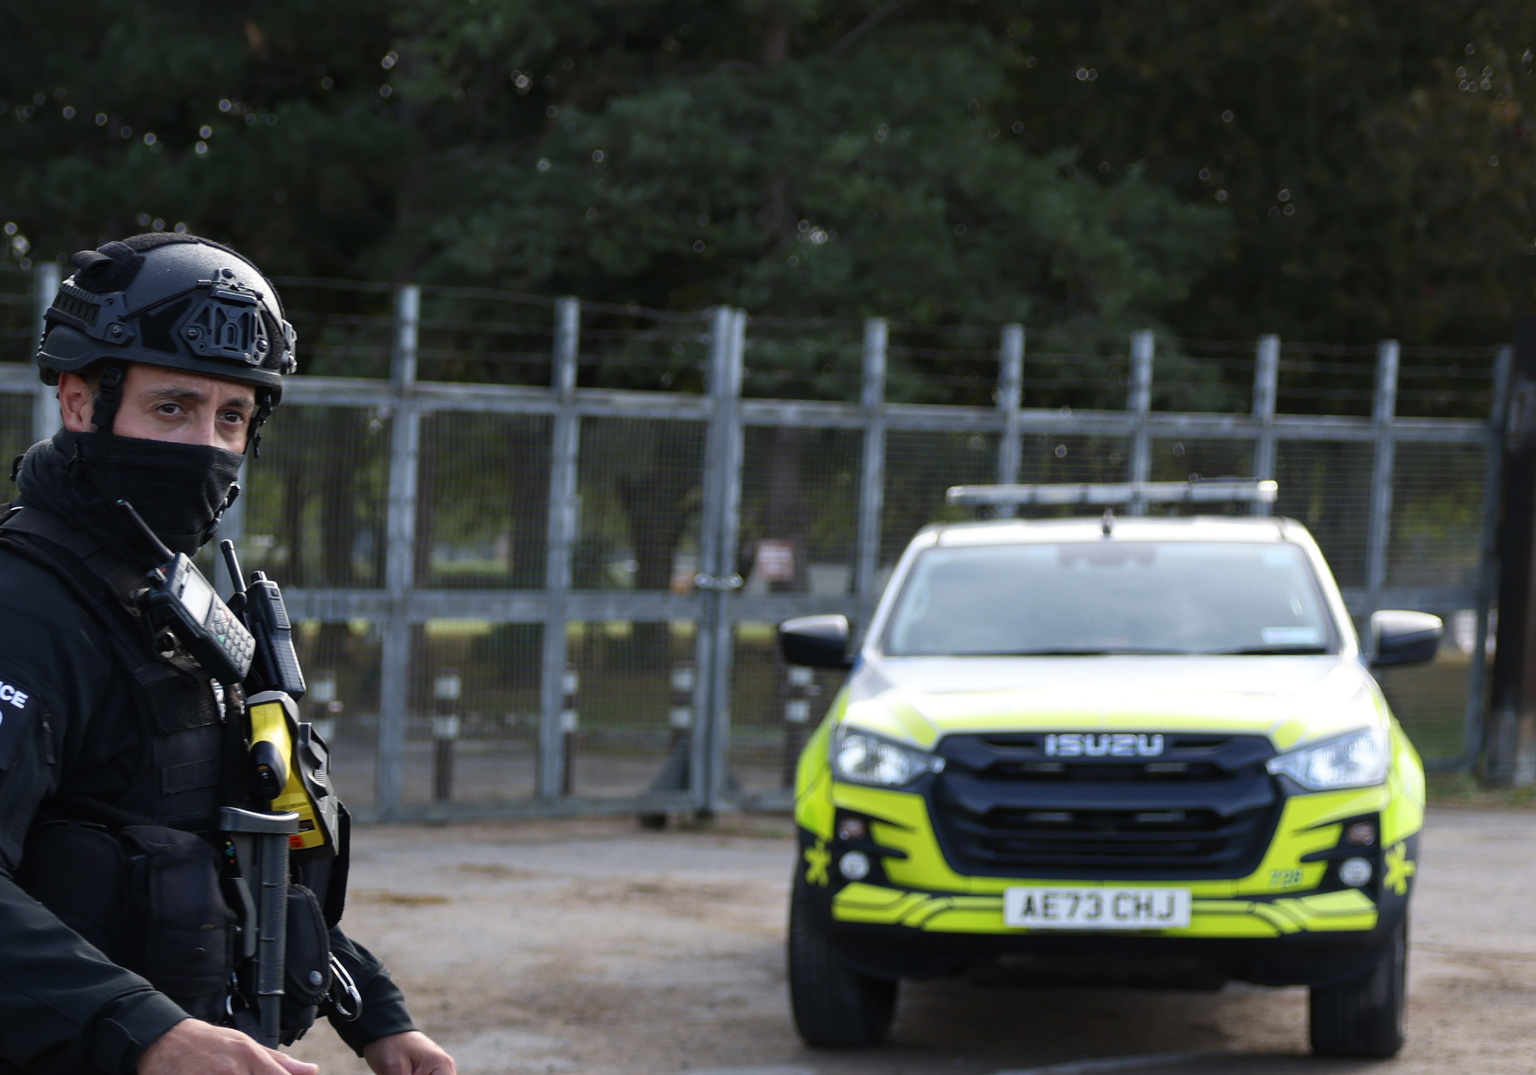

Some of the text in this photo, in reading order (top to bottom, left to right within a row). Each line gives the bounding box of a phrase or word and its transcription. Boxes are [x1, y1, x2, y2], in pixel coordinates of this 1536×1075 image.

[1044, 733, 1164, 757] ISUZU
[1021, 893, 1176, 920] AE73 CHJ
